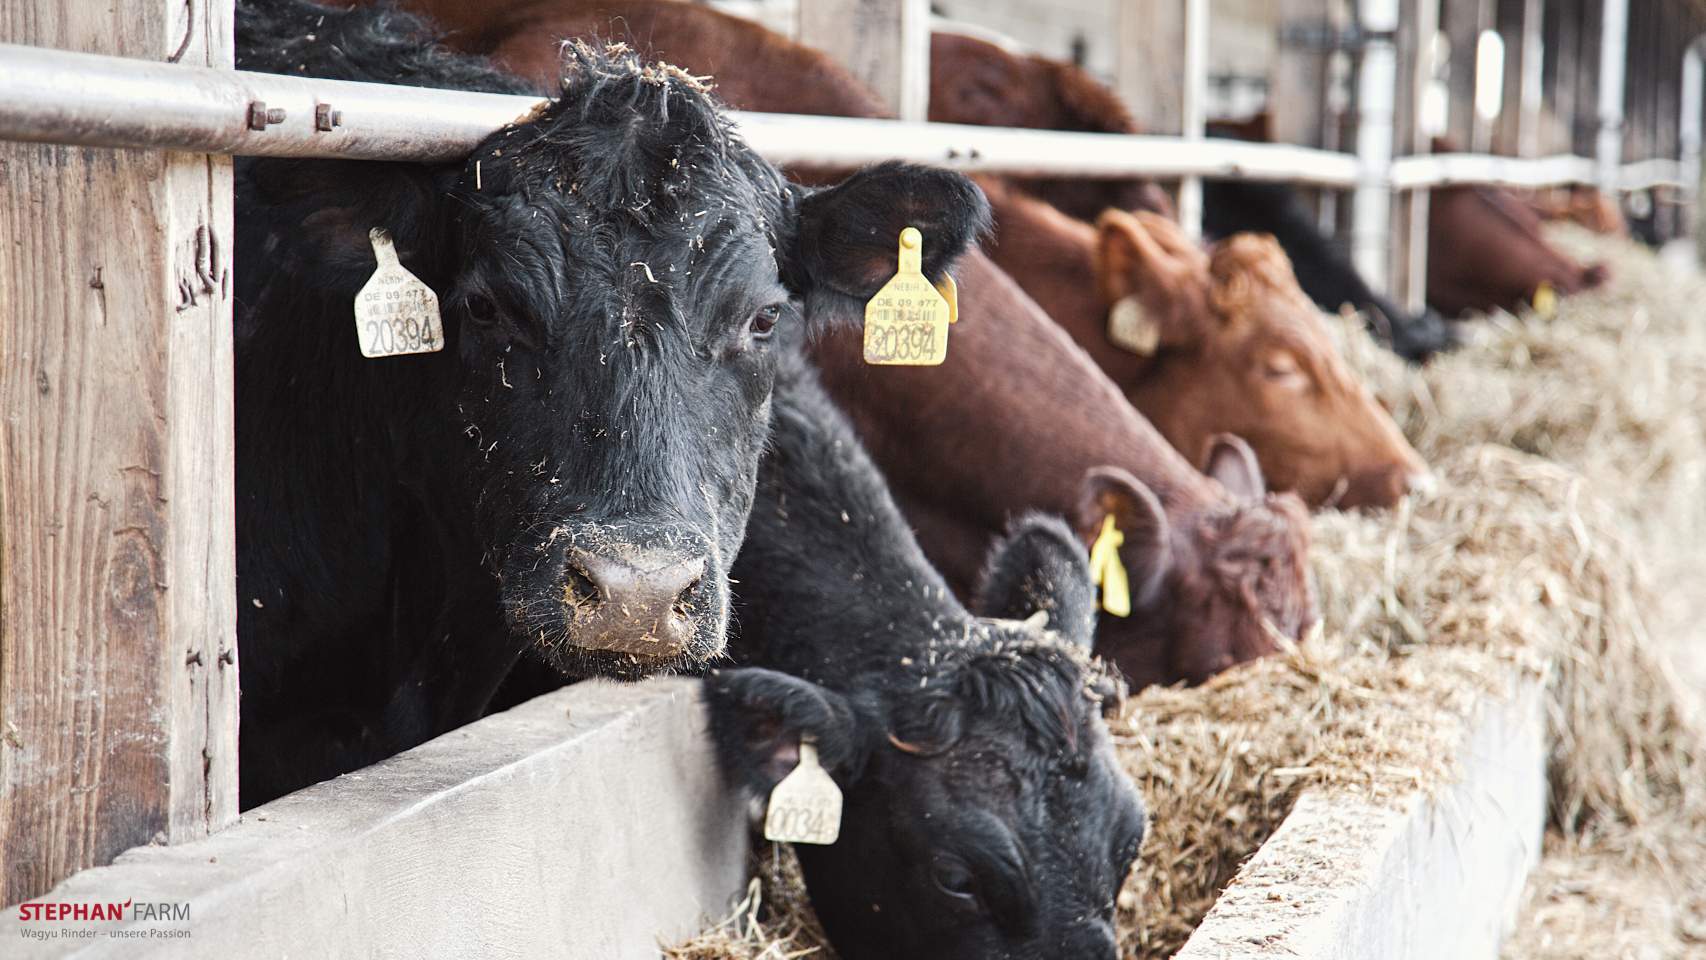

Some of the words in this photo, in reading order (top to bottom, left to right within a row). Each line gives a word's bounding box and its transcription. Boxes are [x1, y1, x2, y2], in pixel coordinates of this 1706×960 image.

[364, 291, 381, 302] DE
[877, 298, 893, 307] DE
[366, 316, 436, 354] 20394
[873, 323, 937, 361] 20394
